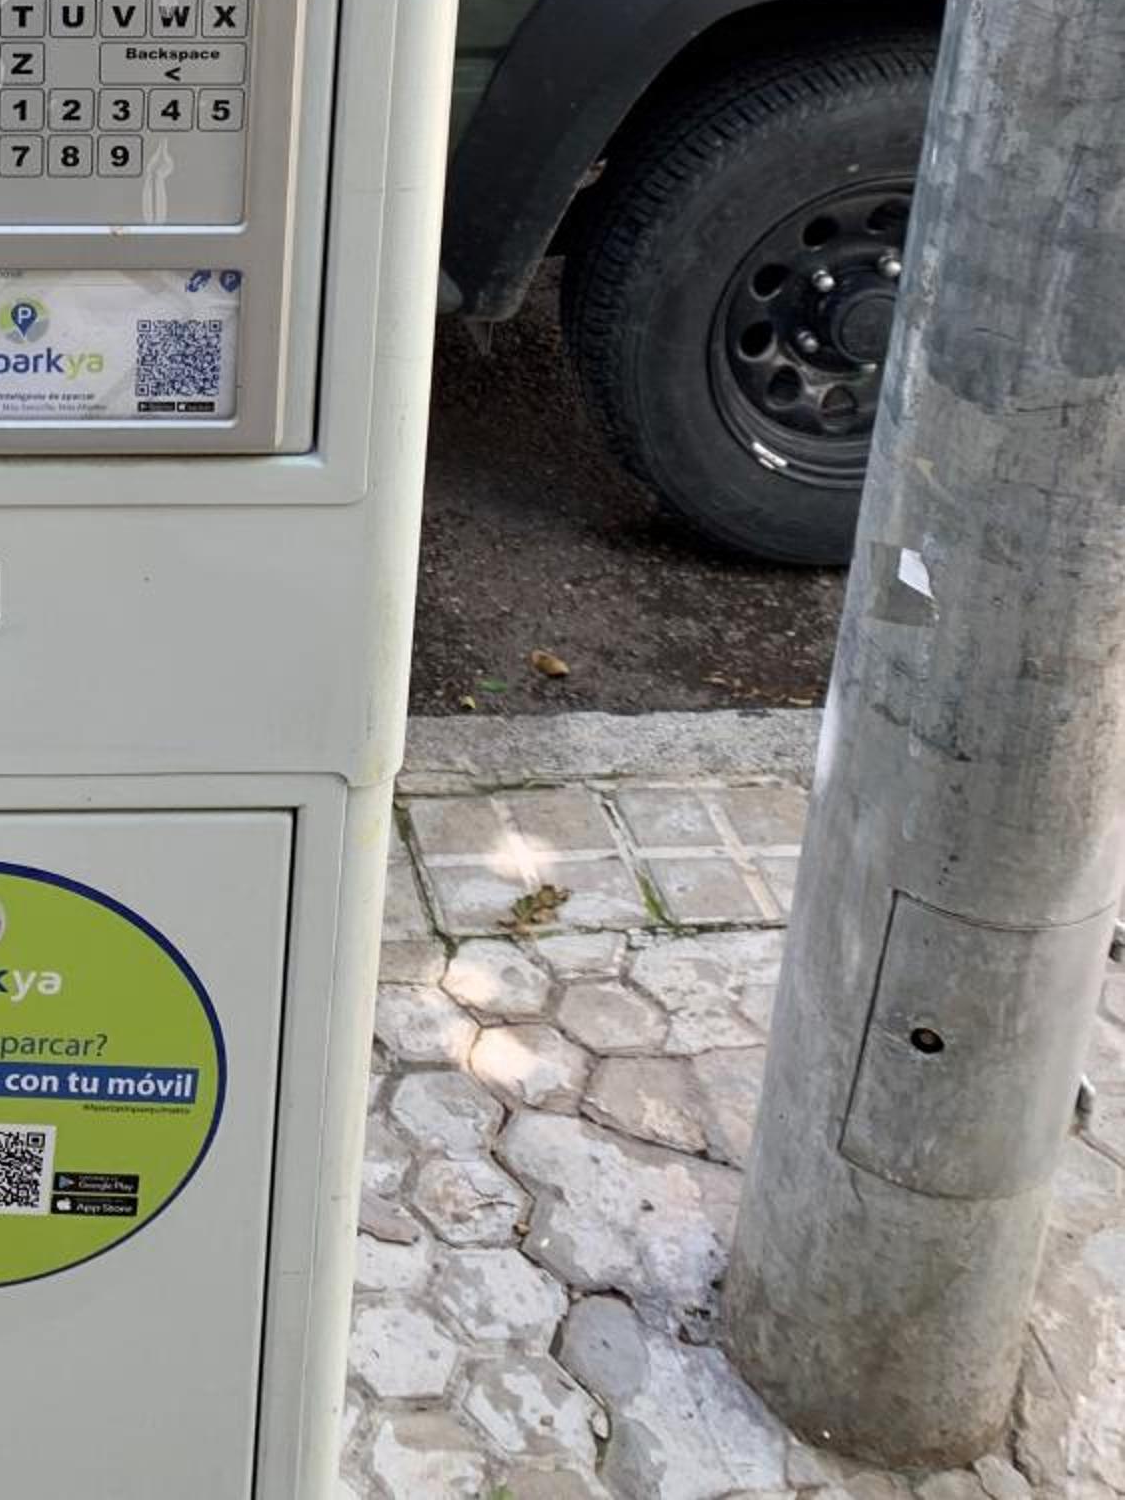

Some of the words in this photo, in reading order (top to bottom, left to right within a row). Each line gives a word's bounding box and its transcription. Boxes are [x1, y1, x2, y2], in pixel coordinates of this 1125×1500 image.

[11, 5, 34, 28] T
[62, 5, 85, 29] U
[112, 5, 136, 28] V
[160, 5, 190, 28] W
[213, 5, 236, 28] X
[10, 53, 34, 75] Z
[125, 47, 220, 62] Backspace
[12, 99, 27, 121] 1
[62, 99, 81, 121] 2
[112, 99, 131, 122] 3
[160, 99, 181, 121] 4
[211, 99, 230, 122] 5
[11, 145, 31, 168] 7
[60, 145, 80, 167] 8
[110, 145, 130, 167] 9
[5, 1071, 60, 1094] con
[68, 1071, 98, 1095] tu
[108, 1071, 193, 1099] móvil
[78, 1181, 112, 1191] Google
[114, 1182, 134, 1191] Play
[76, 1202, 100, 1213] App
[102, 1204, 133, 1213] Store
